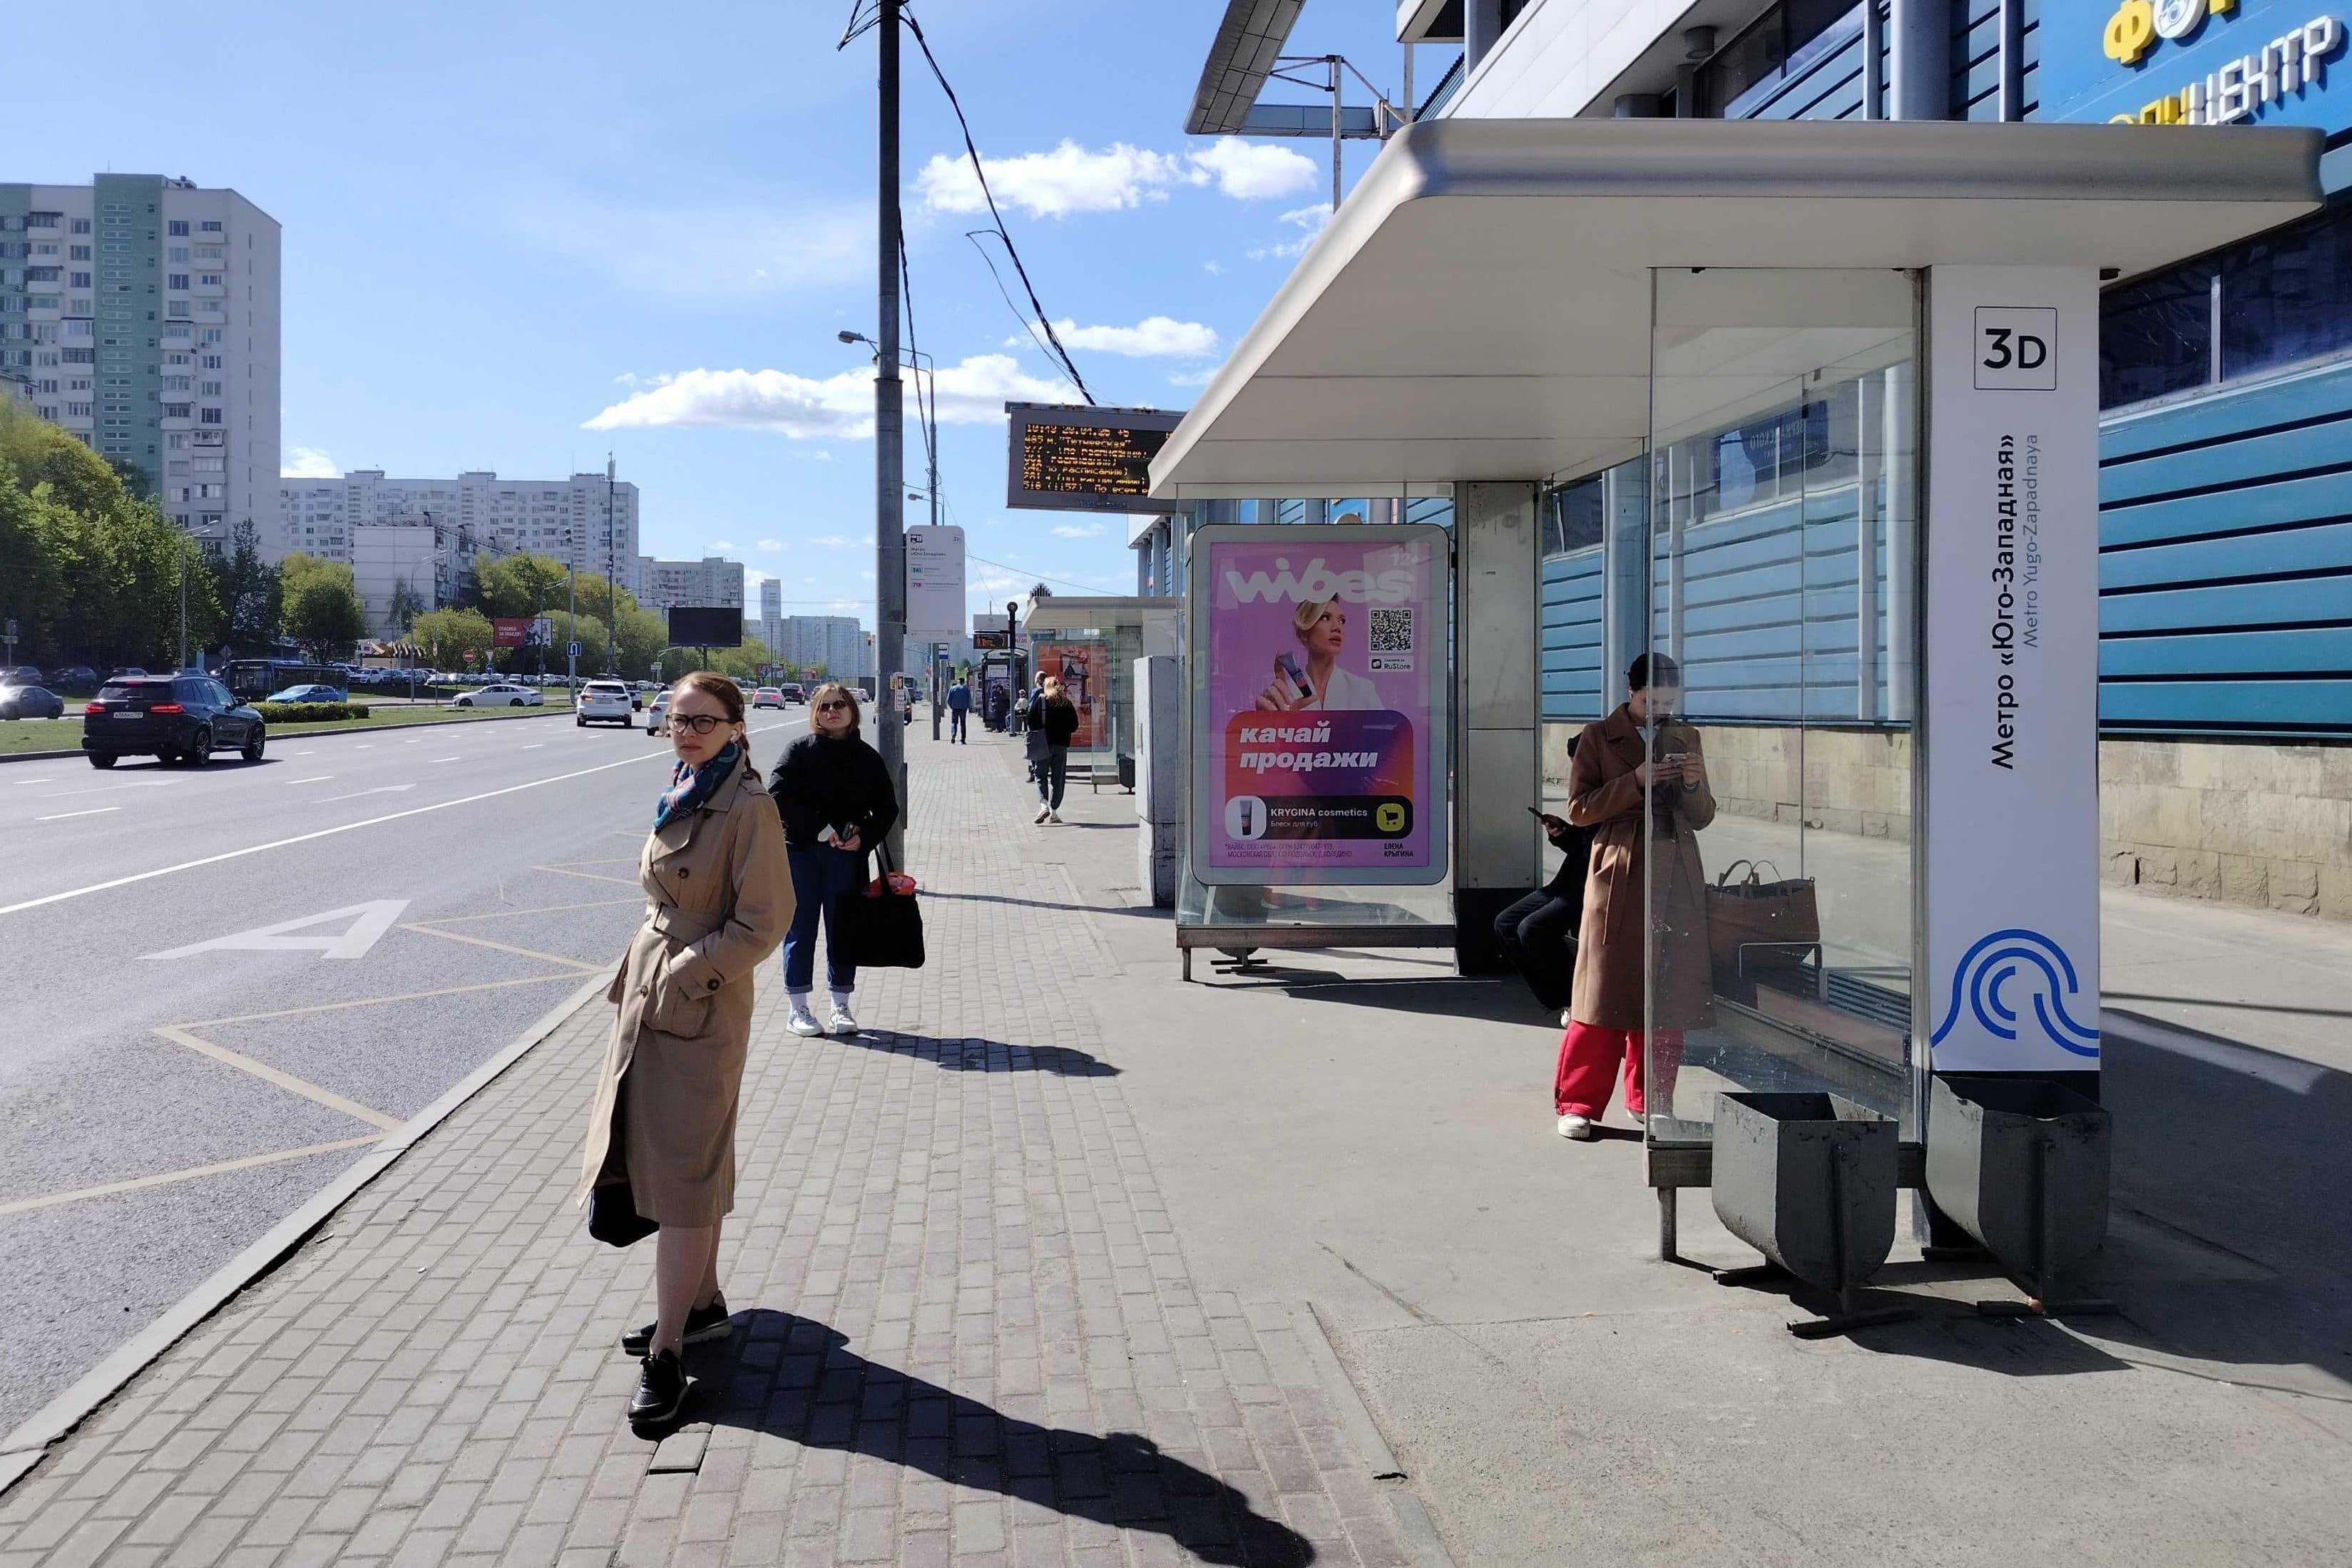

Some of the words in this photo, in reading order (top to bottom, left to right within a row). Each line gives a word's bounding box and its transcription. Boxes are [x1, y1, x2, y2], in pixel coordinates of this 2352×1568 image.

[1983, 328, 2047, 369] 3D
[2023, 435, 2042, 584] Yugo-Zapadnaya
[1991, 434, 2018, 666] «Юго-Западная»
[2023, 588, 2038, 648] Metro
[1239, 720, 1331, 743] качай
[1991, 674, 2018, 769] Метро
[1239, 752, 1378, 774] продажи
[1271, 808, 1316, 816] KRYGINA
[1318, 808, 1368, 816] cosmetics
